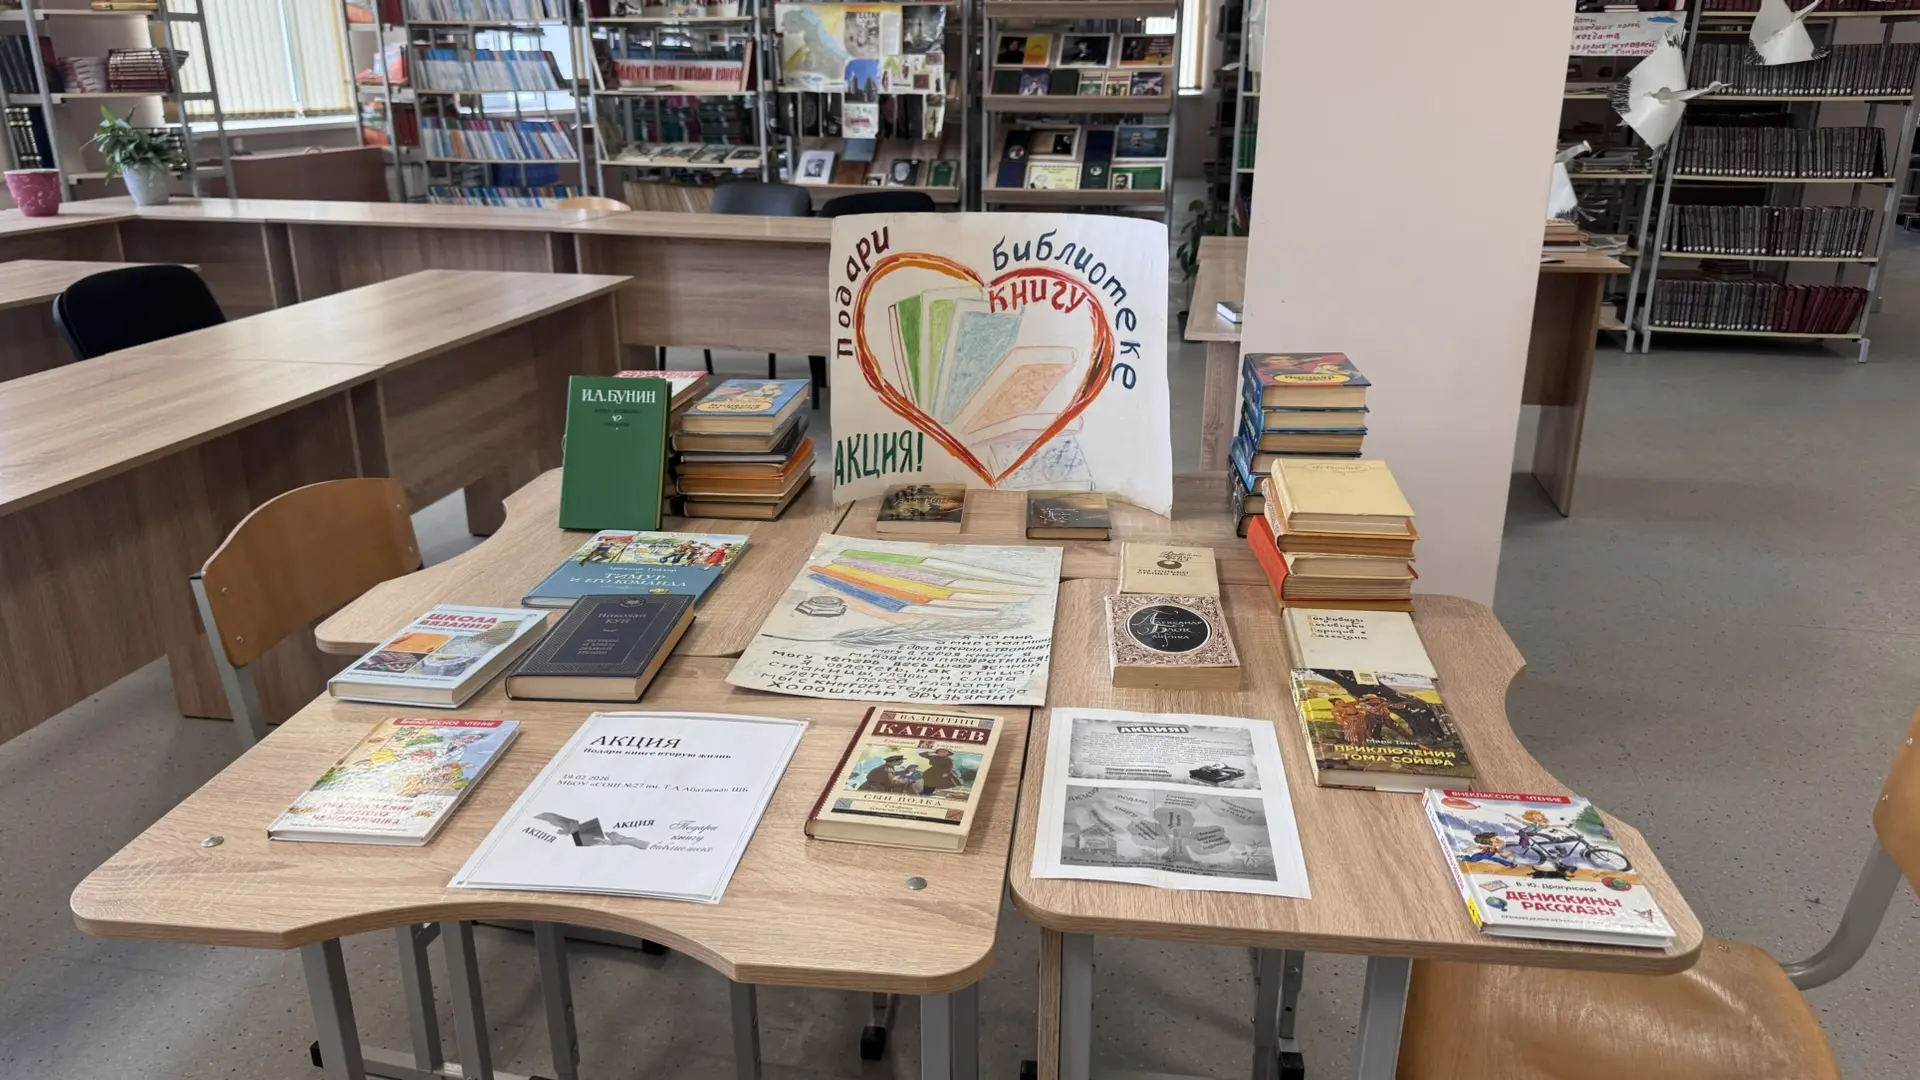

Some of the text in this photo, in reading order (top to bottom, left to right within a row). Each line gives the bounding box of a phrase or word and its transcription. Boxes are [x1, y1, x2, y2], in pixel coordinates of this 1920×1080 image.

[992, 228, 1142, 391] библиотеке
[834, 430, 925, 490] АКЦИЯ!
[604, 572, 667, 581] ТИМУР
[614, 579, 687, 587] КОМАНДА
[426, 613, 499, 624] ШКОЛА
[418, 620, 493, 631] ВЯЗАНИЯ
[878, 723, 986, 742] КАТАЕВ
[1119, 726, 1188, 735] АКЦИЯ!
[589, 735, 682, 750] АКЦИЯ
[583, 747, 623, 756] Подари
[1333, 744, 1457, 759] ПРИКЛЮЧЕНИЯ
[1341, 753, 1455, 767] ТОМА СОЙЕРА
[1451, 791, 1563, 803] ВНЕКЛАССНОЕ ЧТЕНИЕ
[612, 818, 656, 830] АКЦИЯ
[520, 826, 558, 845] АКЦИЯ
[1541, 883, 1598, 893] Драгунский
[1505, 891, 1623, 908] ДЕНИСКИНЫ
[1521, 901, 1617, 917] РАССКАЗЫ
